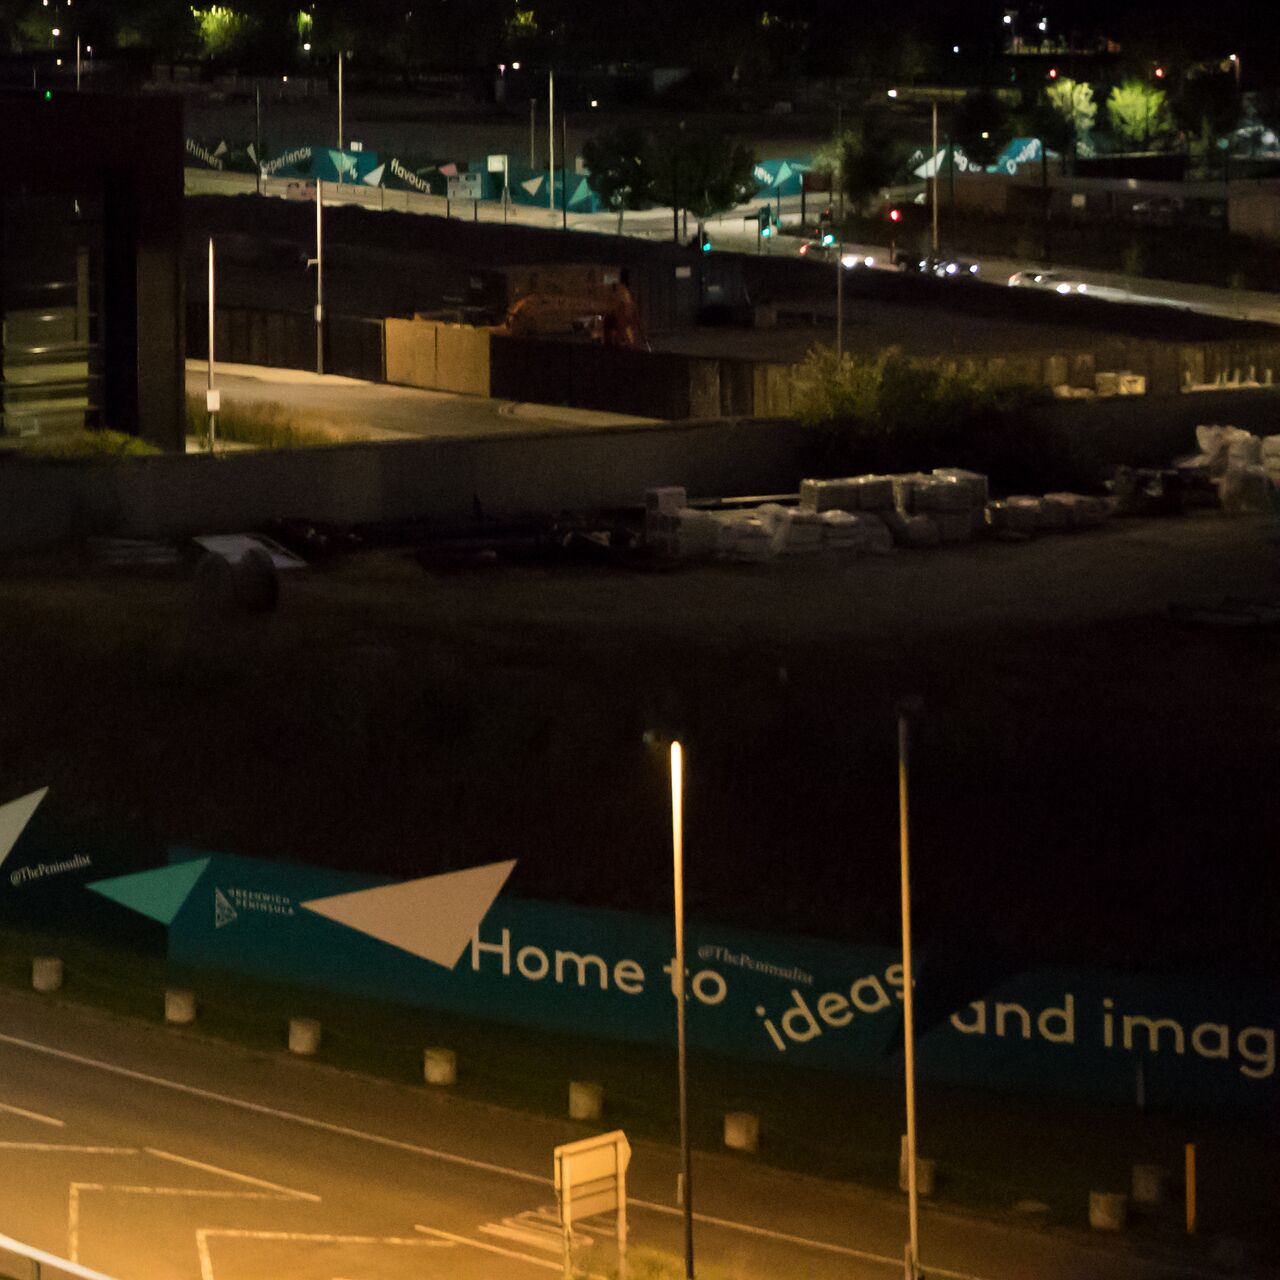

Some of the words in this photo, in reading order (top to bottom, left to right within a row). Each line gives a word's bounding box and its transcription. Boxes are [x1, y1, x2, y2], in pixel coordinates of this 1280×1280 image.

[389, 158, 431, 195] flavours
[10, 854, 91, 886] @ThePeninsulist
[228, 888, 290, 904] GREENWICH
[236, 898, 295, 915] PENINSULA
[471, 925, 646, 995] Home
[662, 956, 727, 1005] to
[755, 963, 916, 1052] ideas
[950, 993, 1075, 1043] and
[1103, 998, 1276, 1079] imag
